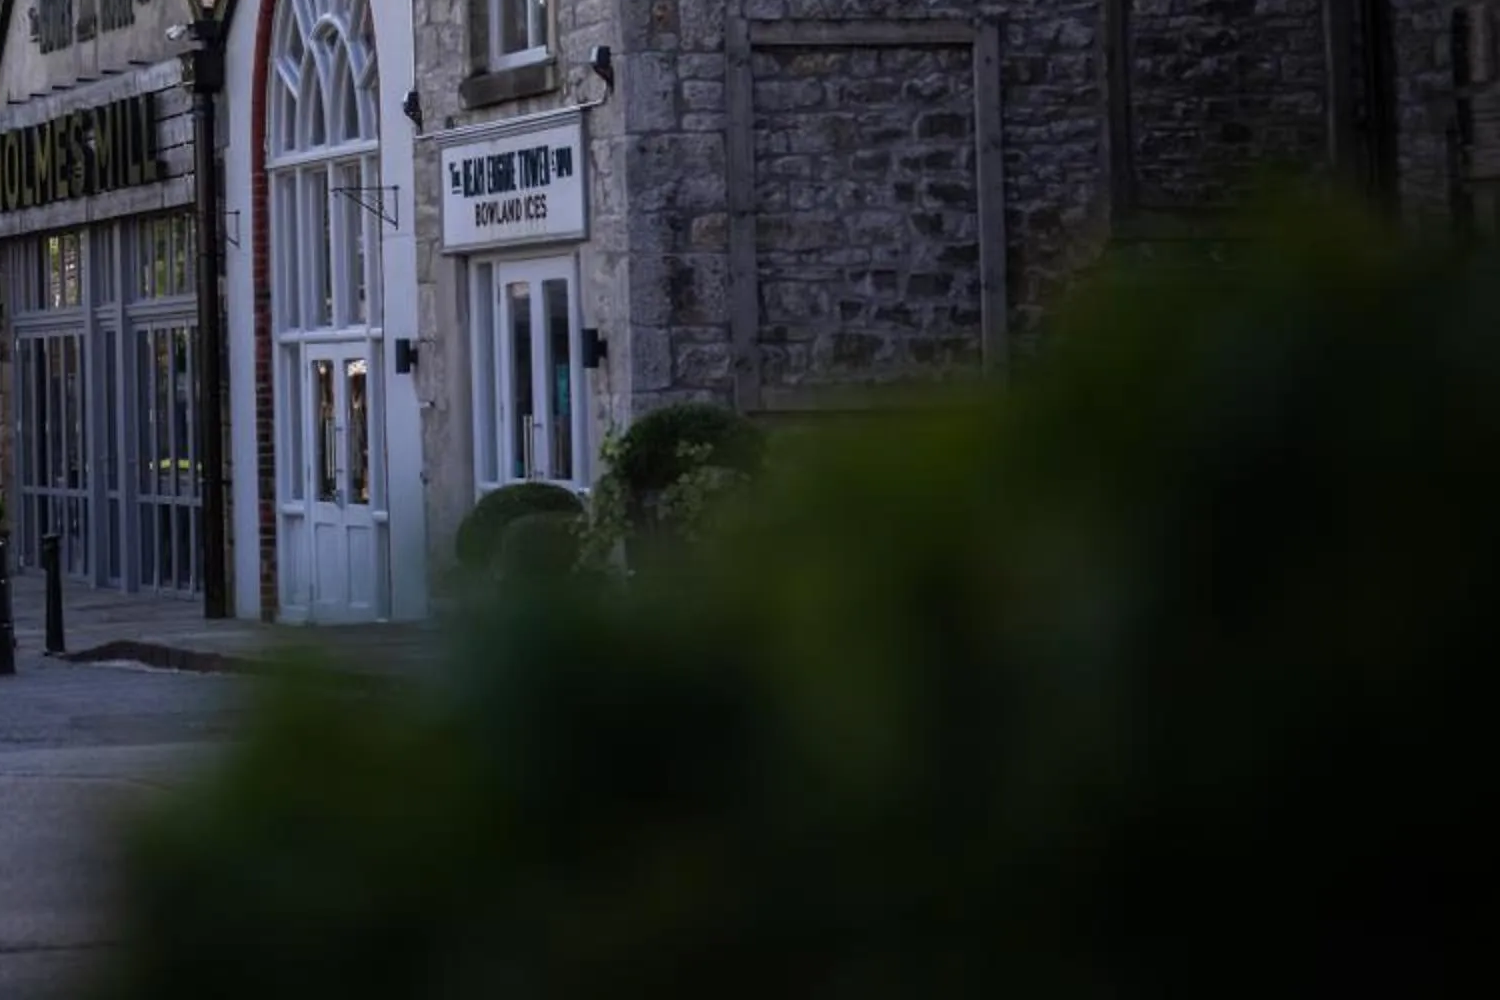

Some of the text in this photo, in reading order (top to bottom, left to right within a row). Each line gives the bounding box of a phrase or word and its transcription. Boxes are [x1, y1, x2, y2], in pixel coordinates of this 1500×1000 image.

[93, 93, 157, 195] MILL
[475, 194, 547, 227] BOWLAND ICES
